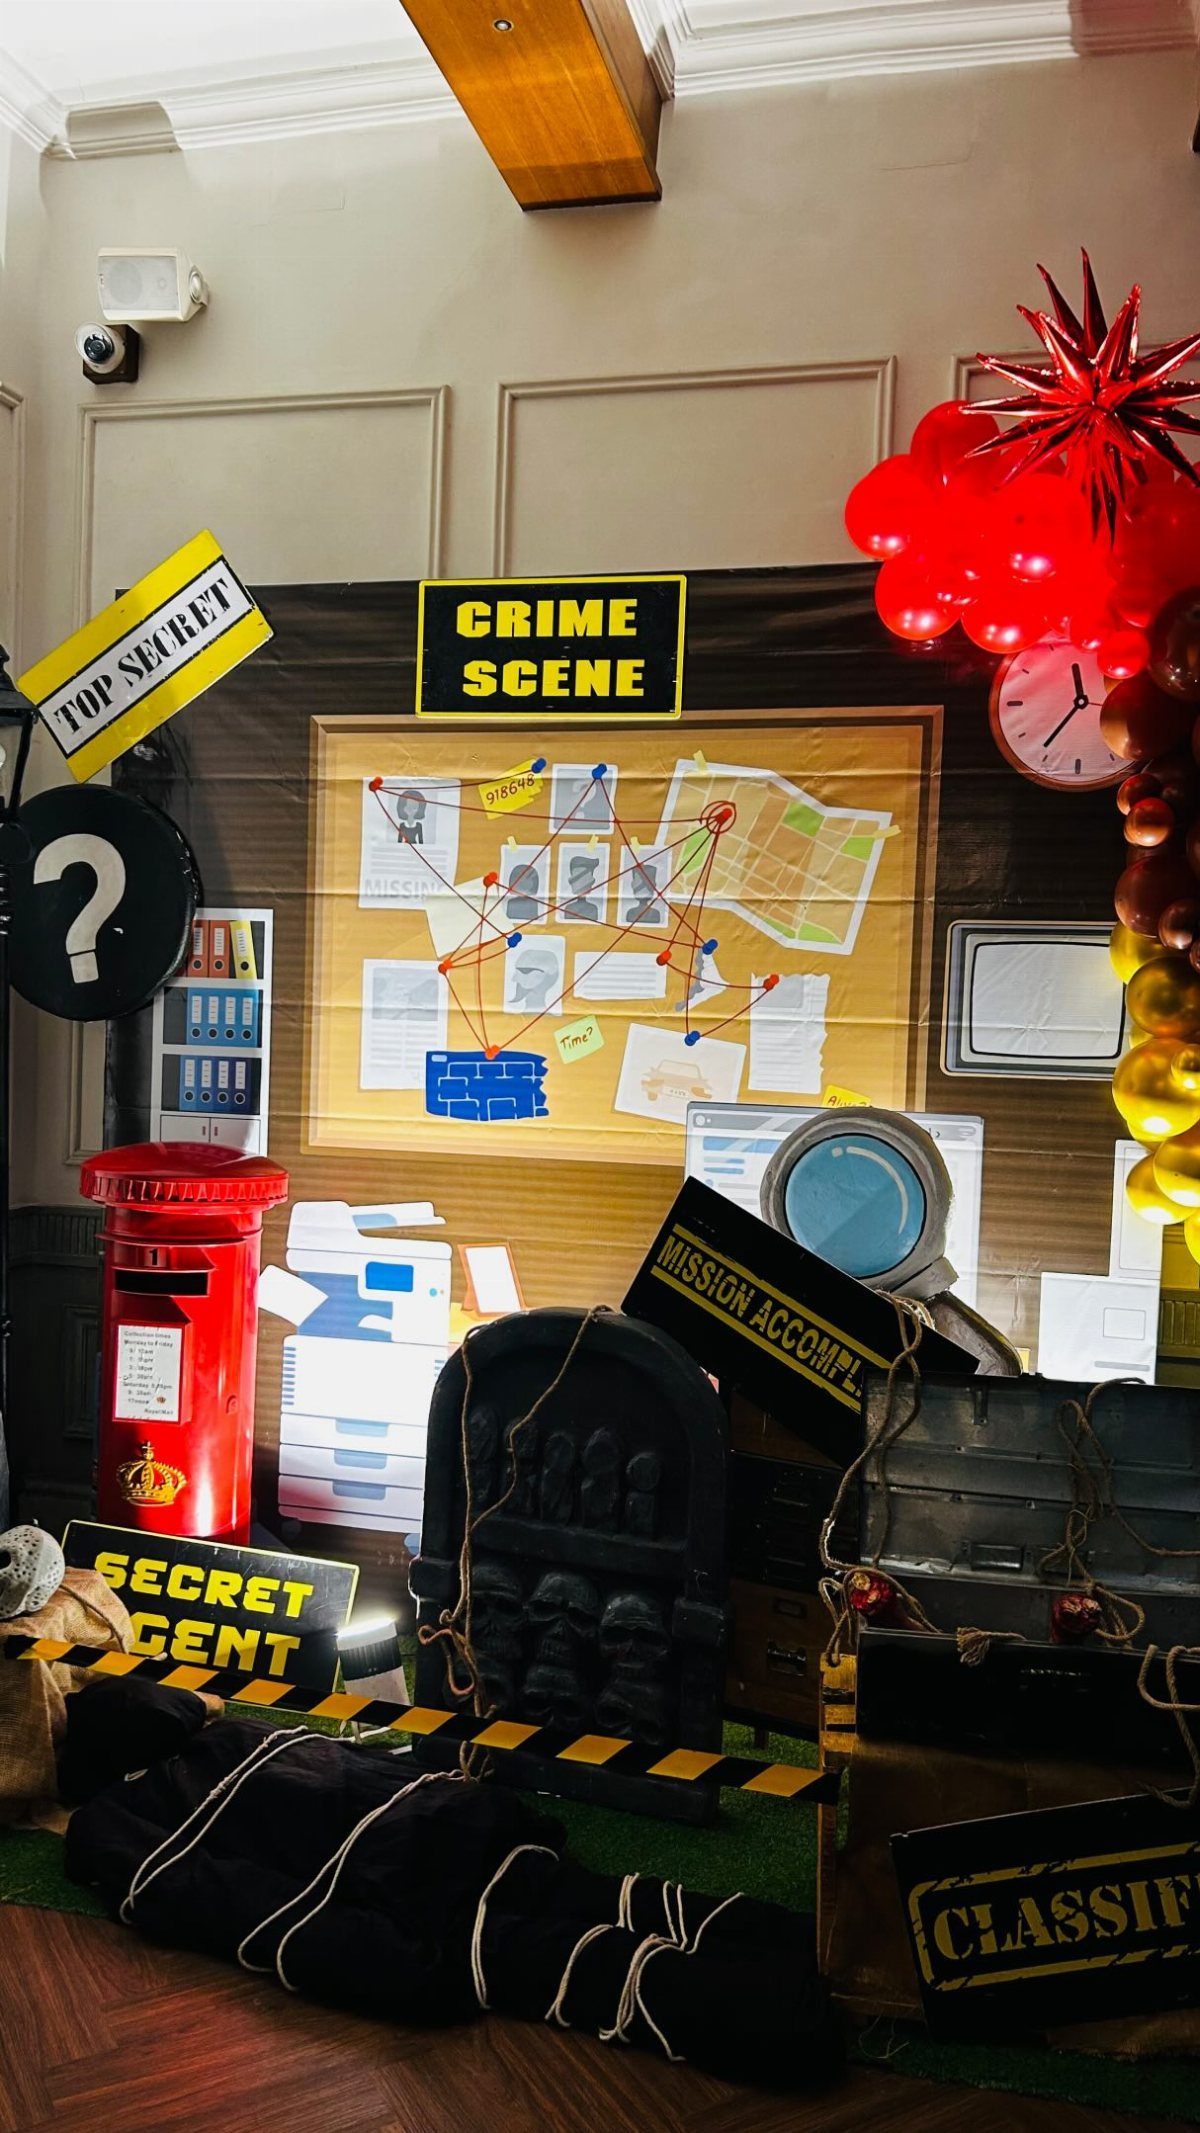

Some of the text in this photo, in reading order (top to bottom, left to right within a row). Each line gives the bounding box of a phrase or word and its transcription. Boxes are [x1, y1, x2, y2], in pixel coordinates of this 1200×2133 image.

[456, 599, 638, 638] CRIME
[53, 578, 232, 735] TOP SECRET
[462, 659, 645, 697] SCENE
[486, 773, 535, 805] 918648
[33, 833, 126, 984] ?
[364, 878, 443, 899] MISSIN
[559, 1026, 594, 1050] Time?
[149, 1248, 158, 1266] 1
[656, 1234, 756, 1318] MISSION
[94, 1551, 314, 1618] SECRET
[130, 1611, 301, 1676] GENT
[934, 1874, 1200, 1960] CLASSIF
